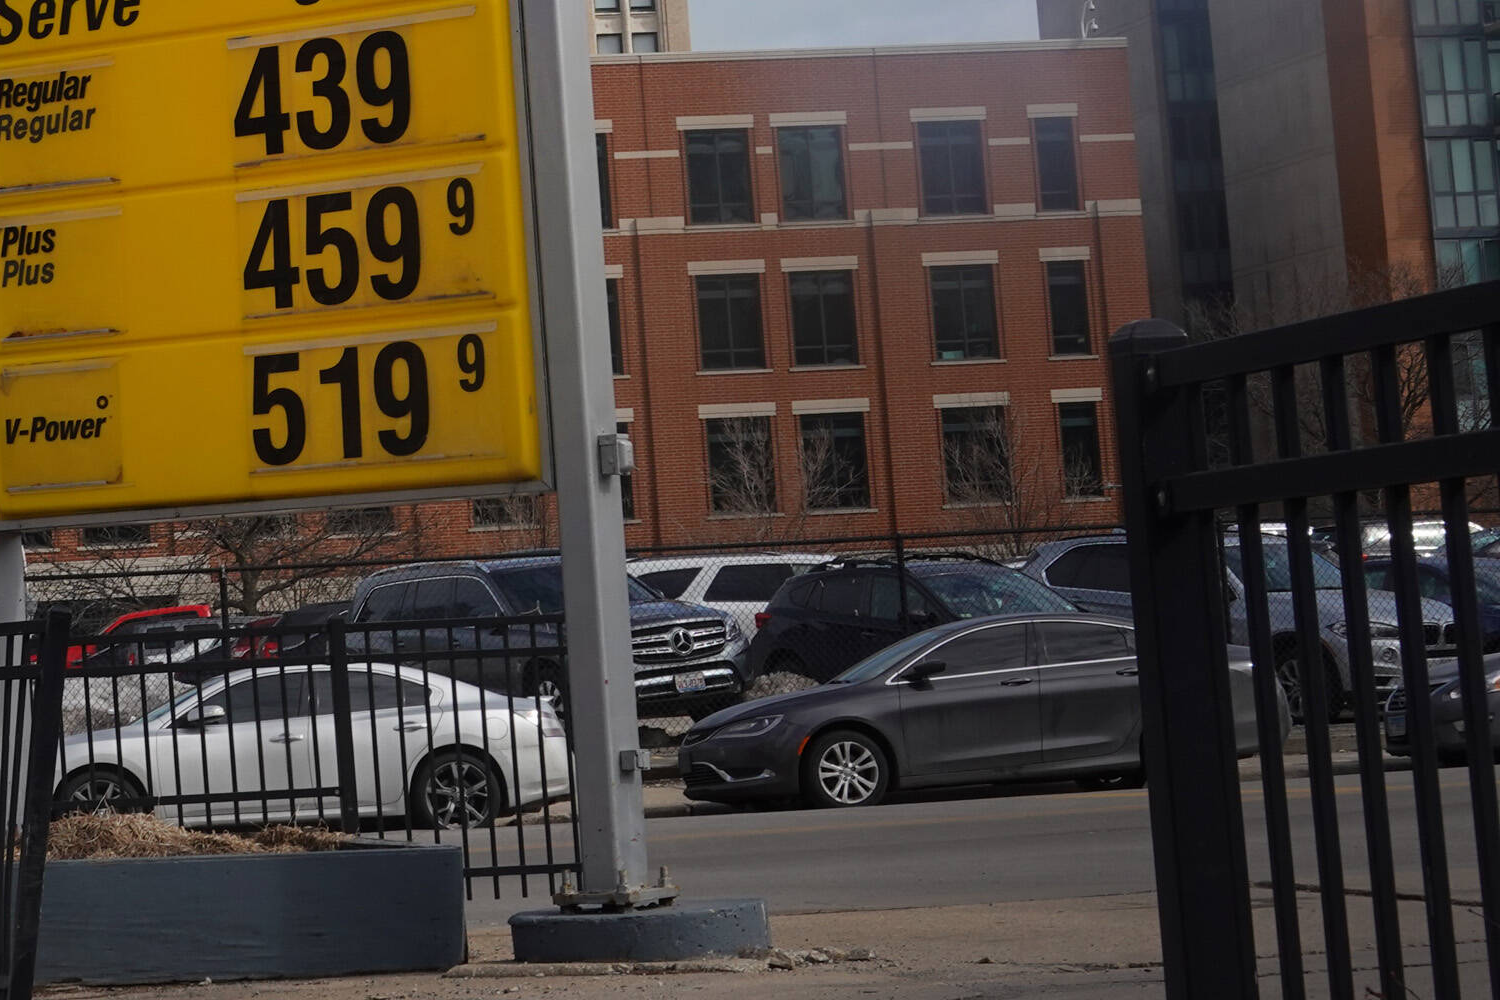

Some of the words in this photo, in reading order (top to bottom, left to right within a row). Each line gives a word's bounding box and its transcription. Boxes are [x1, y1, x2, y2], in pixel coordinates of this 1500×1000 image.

[233, 30, 412, 156] 439
[0, 225, 57, 259] Plus
[1, 257, 56, 288] Plus
[243, 185, 423, 309] 459
[446, 177, 476, 236] 9
[5, 415, 108, 445] V-Power
[252, 340, 431, 467] 519
[457, 333, 487, 393] 9
